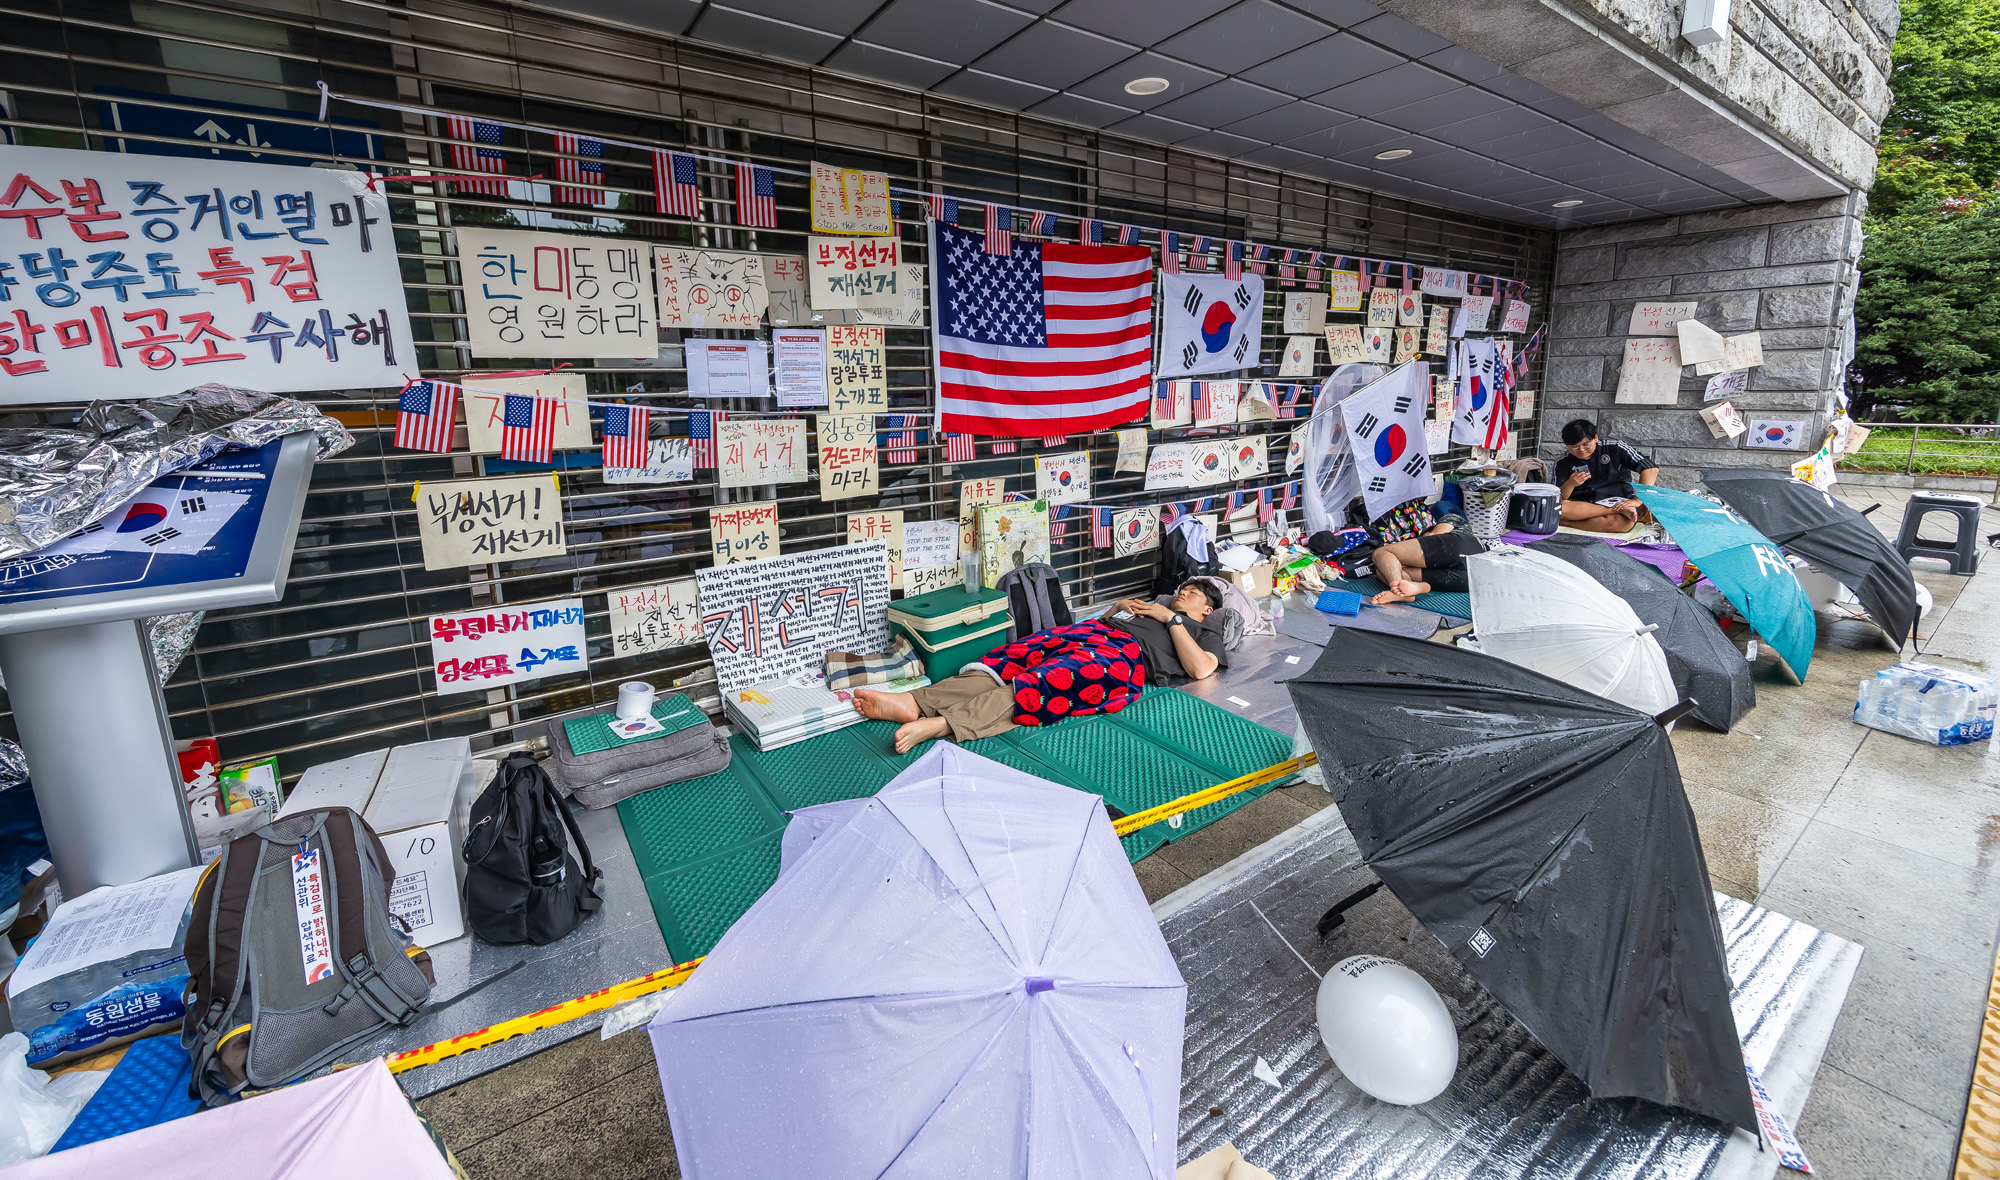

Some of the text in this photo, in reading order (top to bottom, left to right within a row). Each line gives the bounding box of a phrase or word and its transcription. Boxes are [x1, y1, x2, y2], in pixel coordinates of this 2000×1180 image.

[126, 180, 330, 245] 증거인멸
[330, 194, 381, 253] 마
[841, 221, 856, 230] the
[816, 240, 897, 271] 부정선거
[197, 246, 323, 304] 특검
[477, 246, 641, 300] 한미동맹
[828, 271, 897, 297] 재선거
[1421, 271, 1443, 288] MAGA
[1372, 290, 1397, 305] 부정선거
[488, 302, 649, 343] 영원하라
[1371, 307, 1394, 321] 재선거
[0, 305, 398, 377] 한미공조 수사해
[831, 327, 883, 347] 부정선거
[1328, 327, 1359, 346] 부정선거
[833, 349, 880, 366] 재선거
[831, 365, 883, 386] 당일투표
[1209, 384, 1233, 393] 정선거
[1708, 374, 1747, 396] 수개표
[834, 388, 884, 411] 수개표
[821, 414, 877, 443] 장동혁
[1211, 410, 1233, 422] 정선거
[723, 435, 793, 473] 재선거
[821, 445, 878, 470] 건드리지
[831, 467, 872, 491] 마라
[963, 480, 996, 500] 자유는
[428, 487, 542, 535] 부정선거!
[710, 505, 778, 539] 가짜당선자
[960, 517, 977, 530] 주어
[471, 521, 562, 556] 재선거!
[848, 515, 893, 538] 자유는
[934, 543, 952, 551] STEAL
[913, 562, 960, 596] 부정선거
[612, 586, 671, 616] 부정선거
[641, 594, 700, 626] 재선거
[432, 607, 584, 643] 부정선거 재선거
[703, 575, 867, 659] 재선거
[616, 622, 673, 651] 당일투표
[437, 645, 580, 683] 당일투표 수개표
[406, 837, 436, 859] 10
[296, 876, 318, 965] 선관위 압색자료
[308, 873, 329, 958] 특검으로 밝혀내자
[86, 991, 162, 1026] 동원샘물
